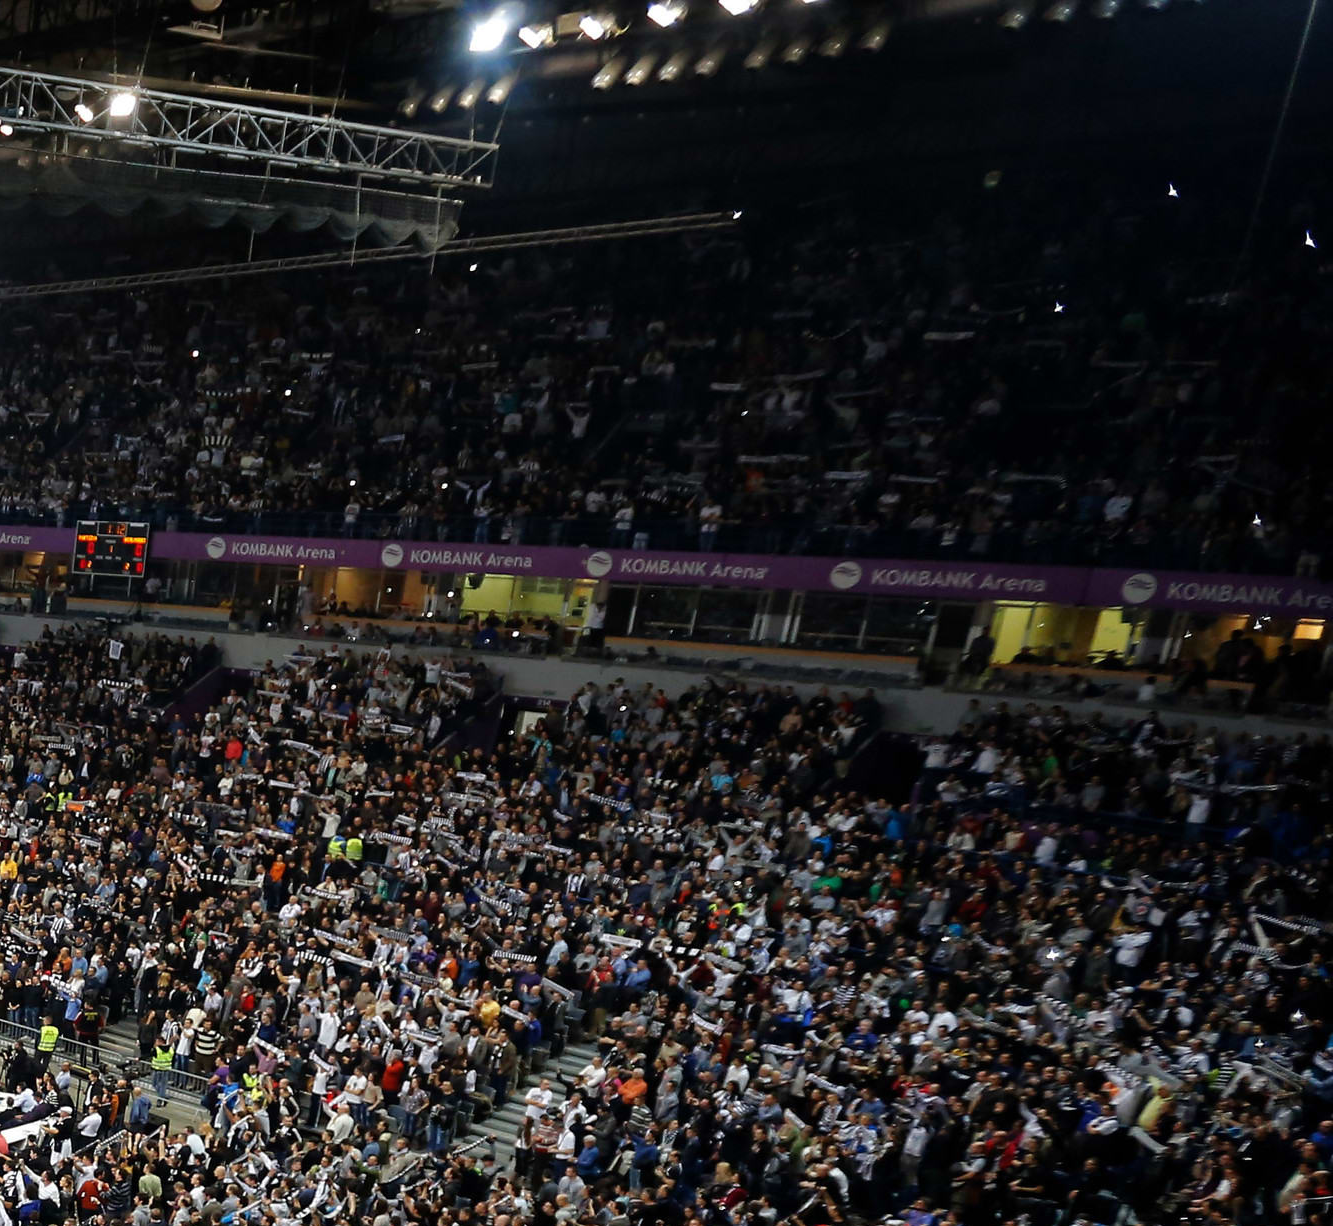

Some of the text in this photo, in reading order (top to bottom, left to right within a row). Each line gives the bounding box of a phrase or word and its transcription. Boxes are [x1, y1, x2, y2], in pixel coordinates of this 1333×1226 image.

[0, 534, 30, 545] Arena
[232, 543, 336, 559] KOMBANK Arena
[410, 549, 533, 568] KOMBANK Arena
[620, 557, 766, 580] KOMBANK Arena
[871, 569, 1047, 593] KOMBANK Arena
[1167, 582, 1284, 606] KOMBANK
